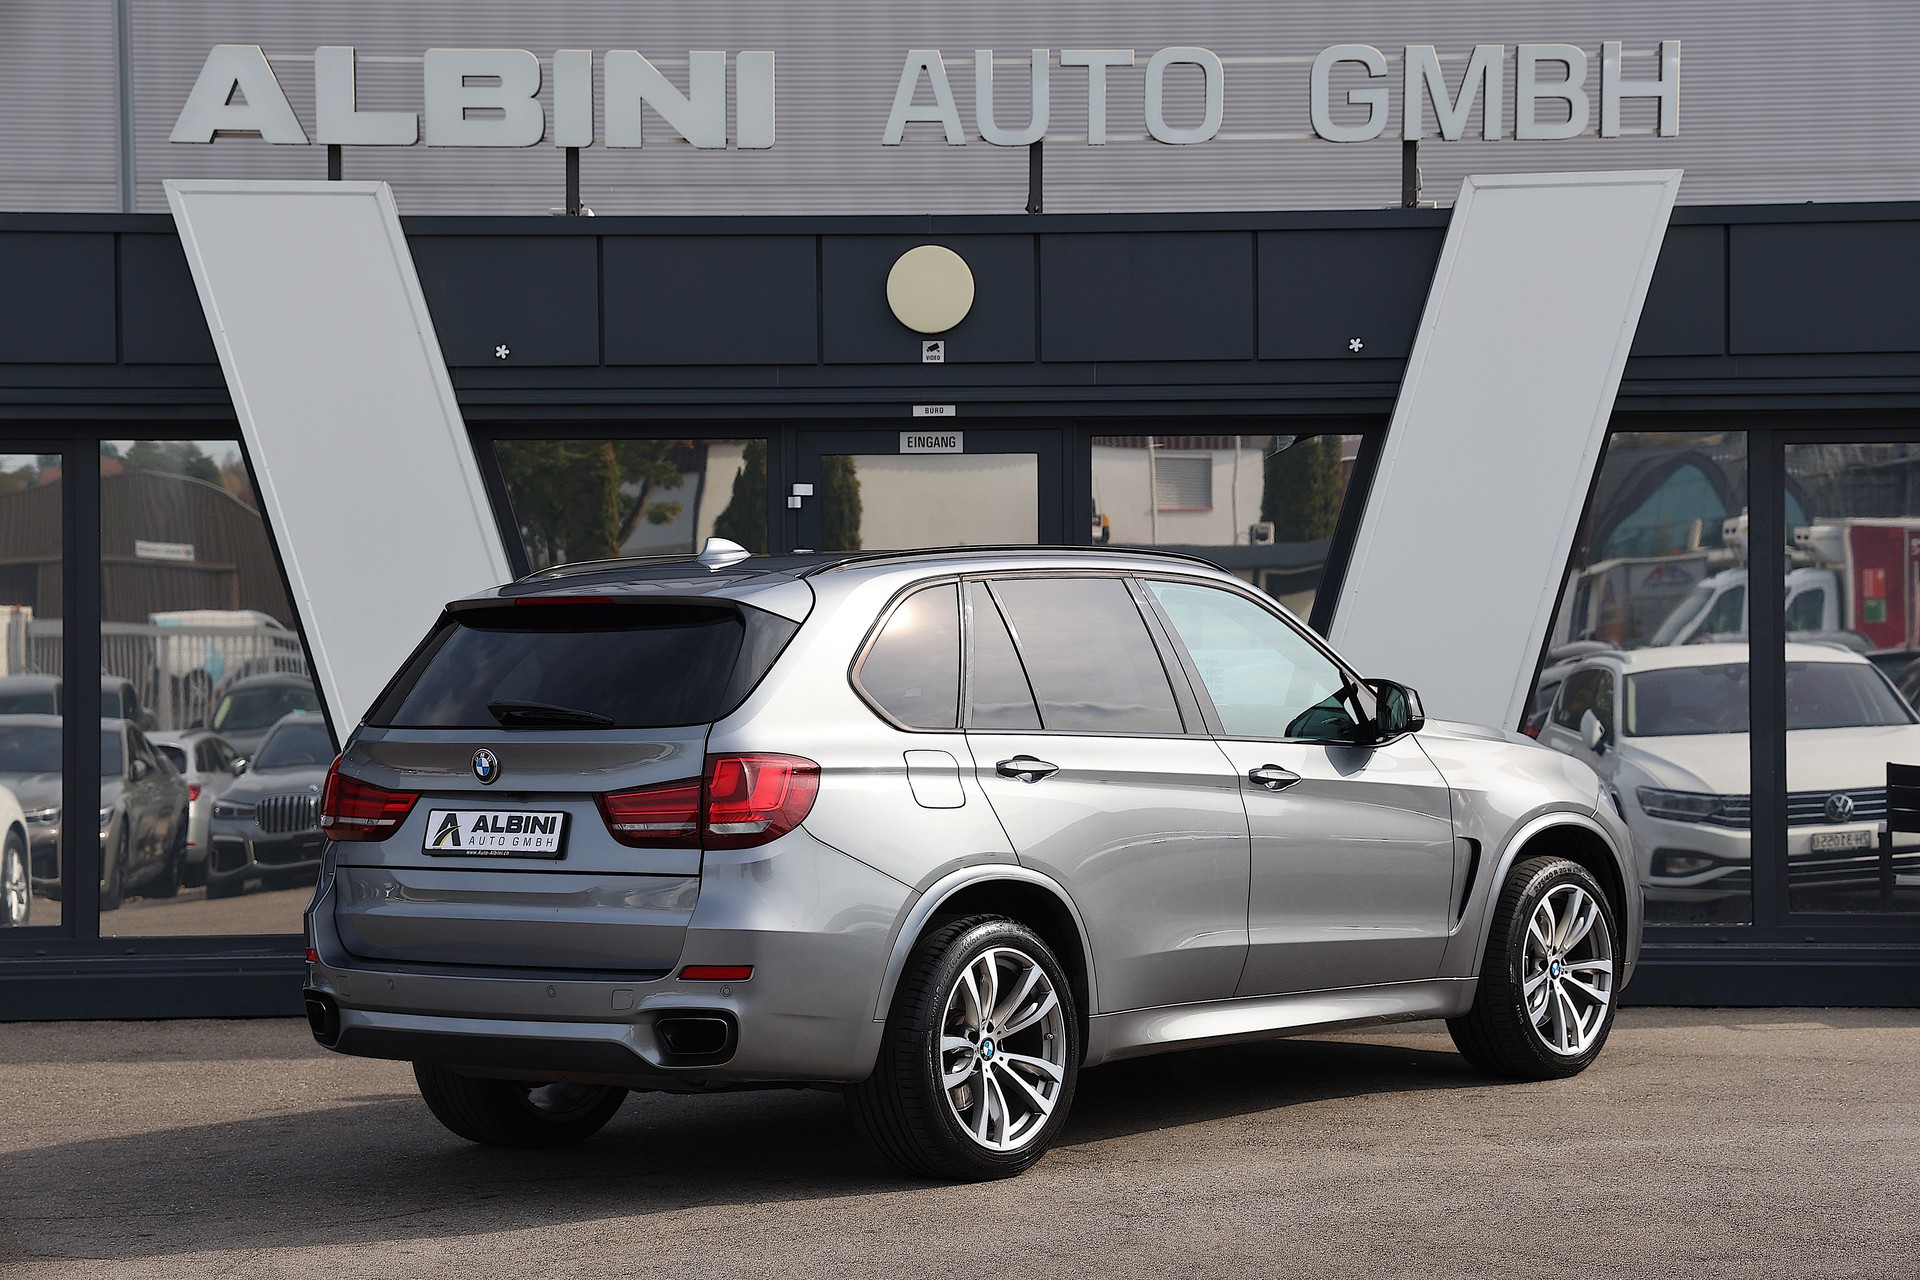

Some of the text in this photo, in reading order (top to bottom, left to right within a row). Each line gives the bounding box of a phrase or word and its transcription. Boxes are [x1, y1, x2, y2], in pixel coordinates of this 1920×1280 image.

[169, 40, 1682, 150] ALBINI AUTO GMBH
[907, 436, 956, 448] EINGANG
[471, 814, 557, 835] ALBINI
[468, 836, 553, 847] AUTO GMBH
